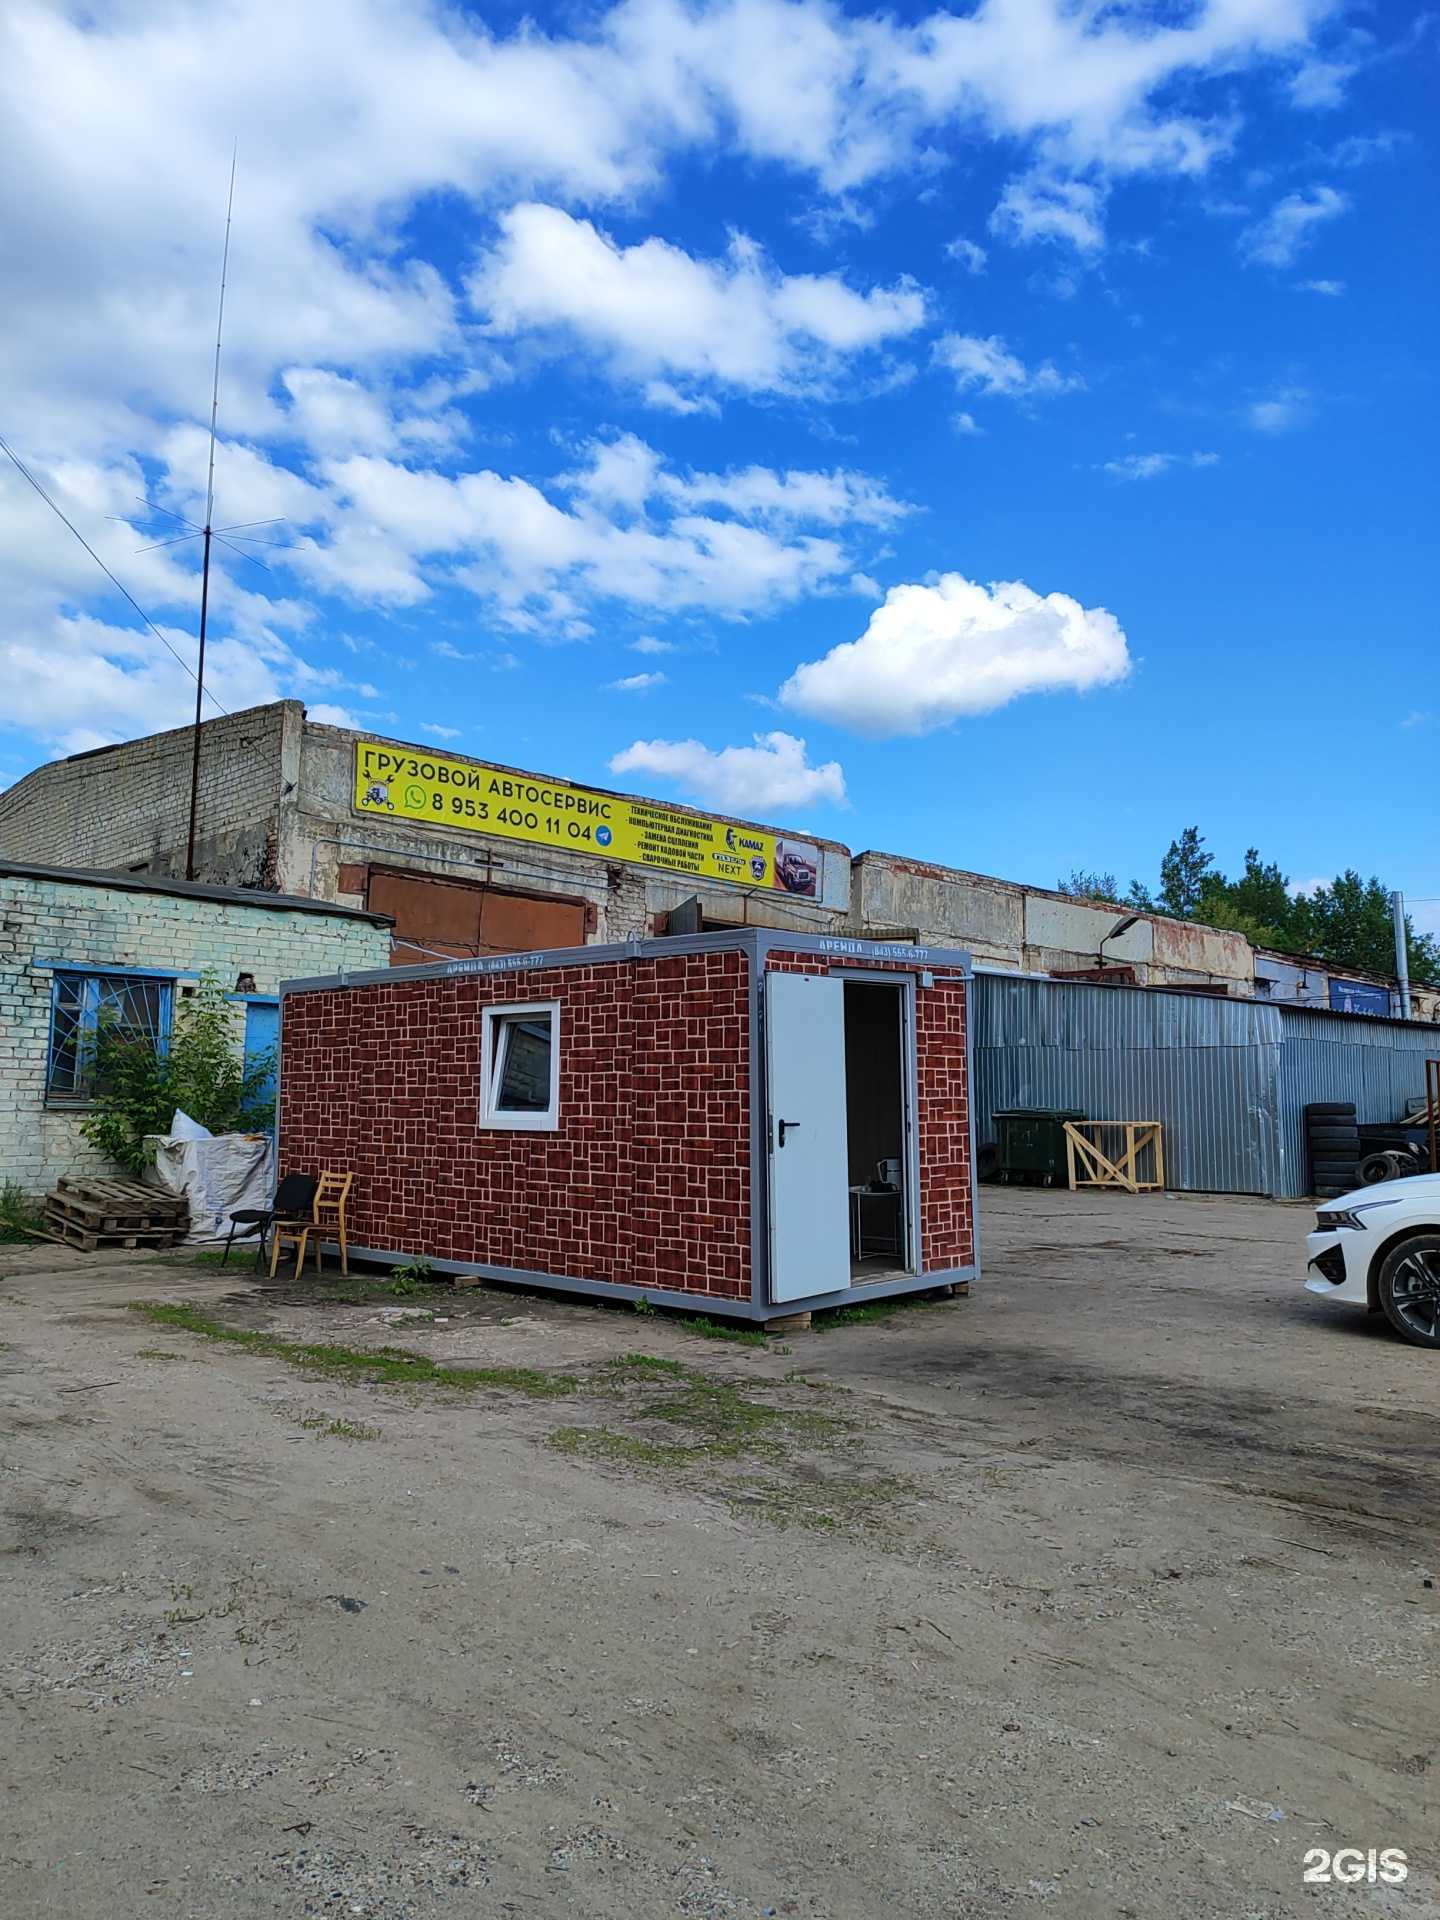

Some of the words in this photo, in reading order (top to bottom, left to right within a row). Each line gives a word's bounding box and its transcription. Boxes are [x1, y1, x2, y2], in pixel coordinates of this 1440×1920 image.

[365, 750, 480, 790] ГРУЗОВОЙ
[488, 779, 612, 819] АВТОСЕРВИС
[432, 793, 443, 810] 8
[452, 797, 489, 820] 953
[497, 807, 538, 829] 400
[546, 818, 560, 835] 11
[567, 822, 591, 841] 04
[631, 806, 669, 821] ТЕХНИЧЕСКОЕ
[670, 814, 712, 831] ОБСЛУЖИВАНИЕ
[628, 817, 675, 833] КОМПЬЮТЕРНАЯ
[675, 826, 714, 842] ДИАГНОСТИКА
[644, 831, 666, 843] ЗАМЕНА
[637, 841, 659, 852] РЕМОНТ
[687, 851, 705, 861] ЧАСТИ
[739, 838, 764, 852] KAMAZ
[642, 853, 676, 867] СВАРОЧНЫЕ
[677, 860, 700, 872] РАБОТЫ
[718, 863, 742, 876] NEXT
[819, 940, 862, 953] АРЕНДА
